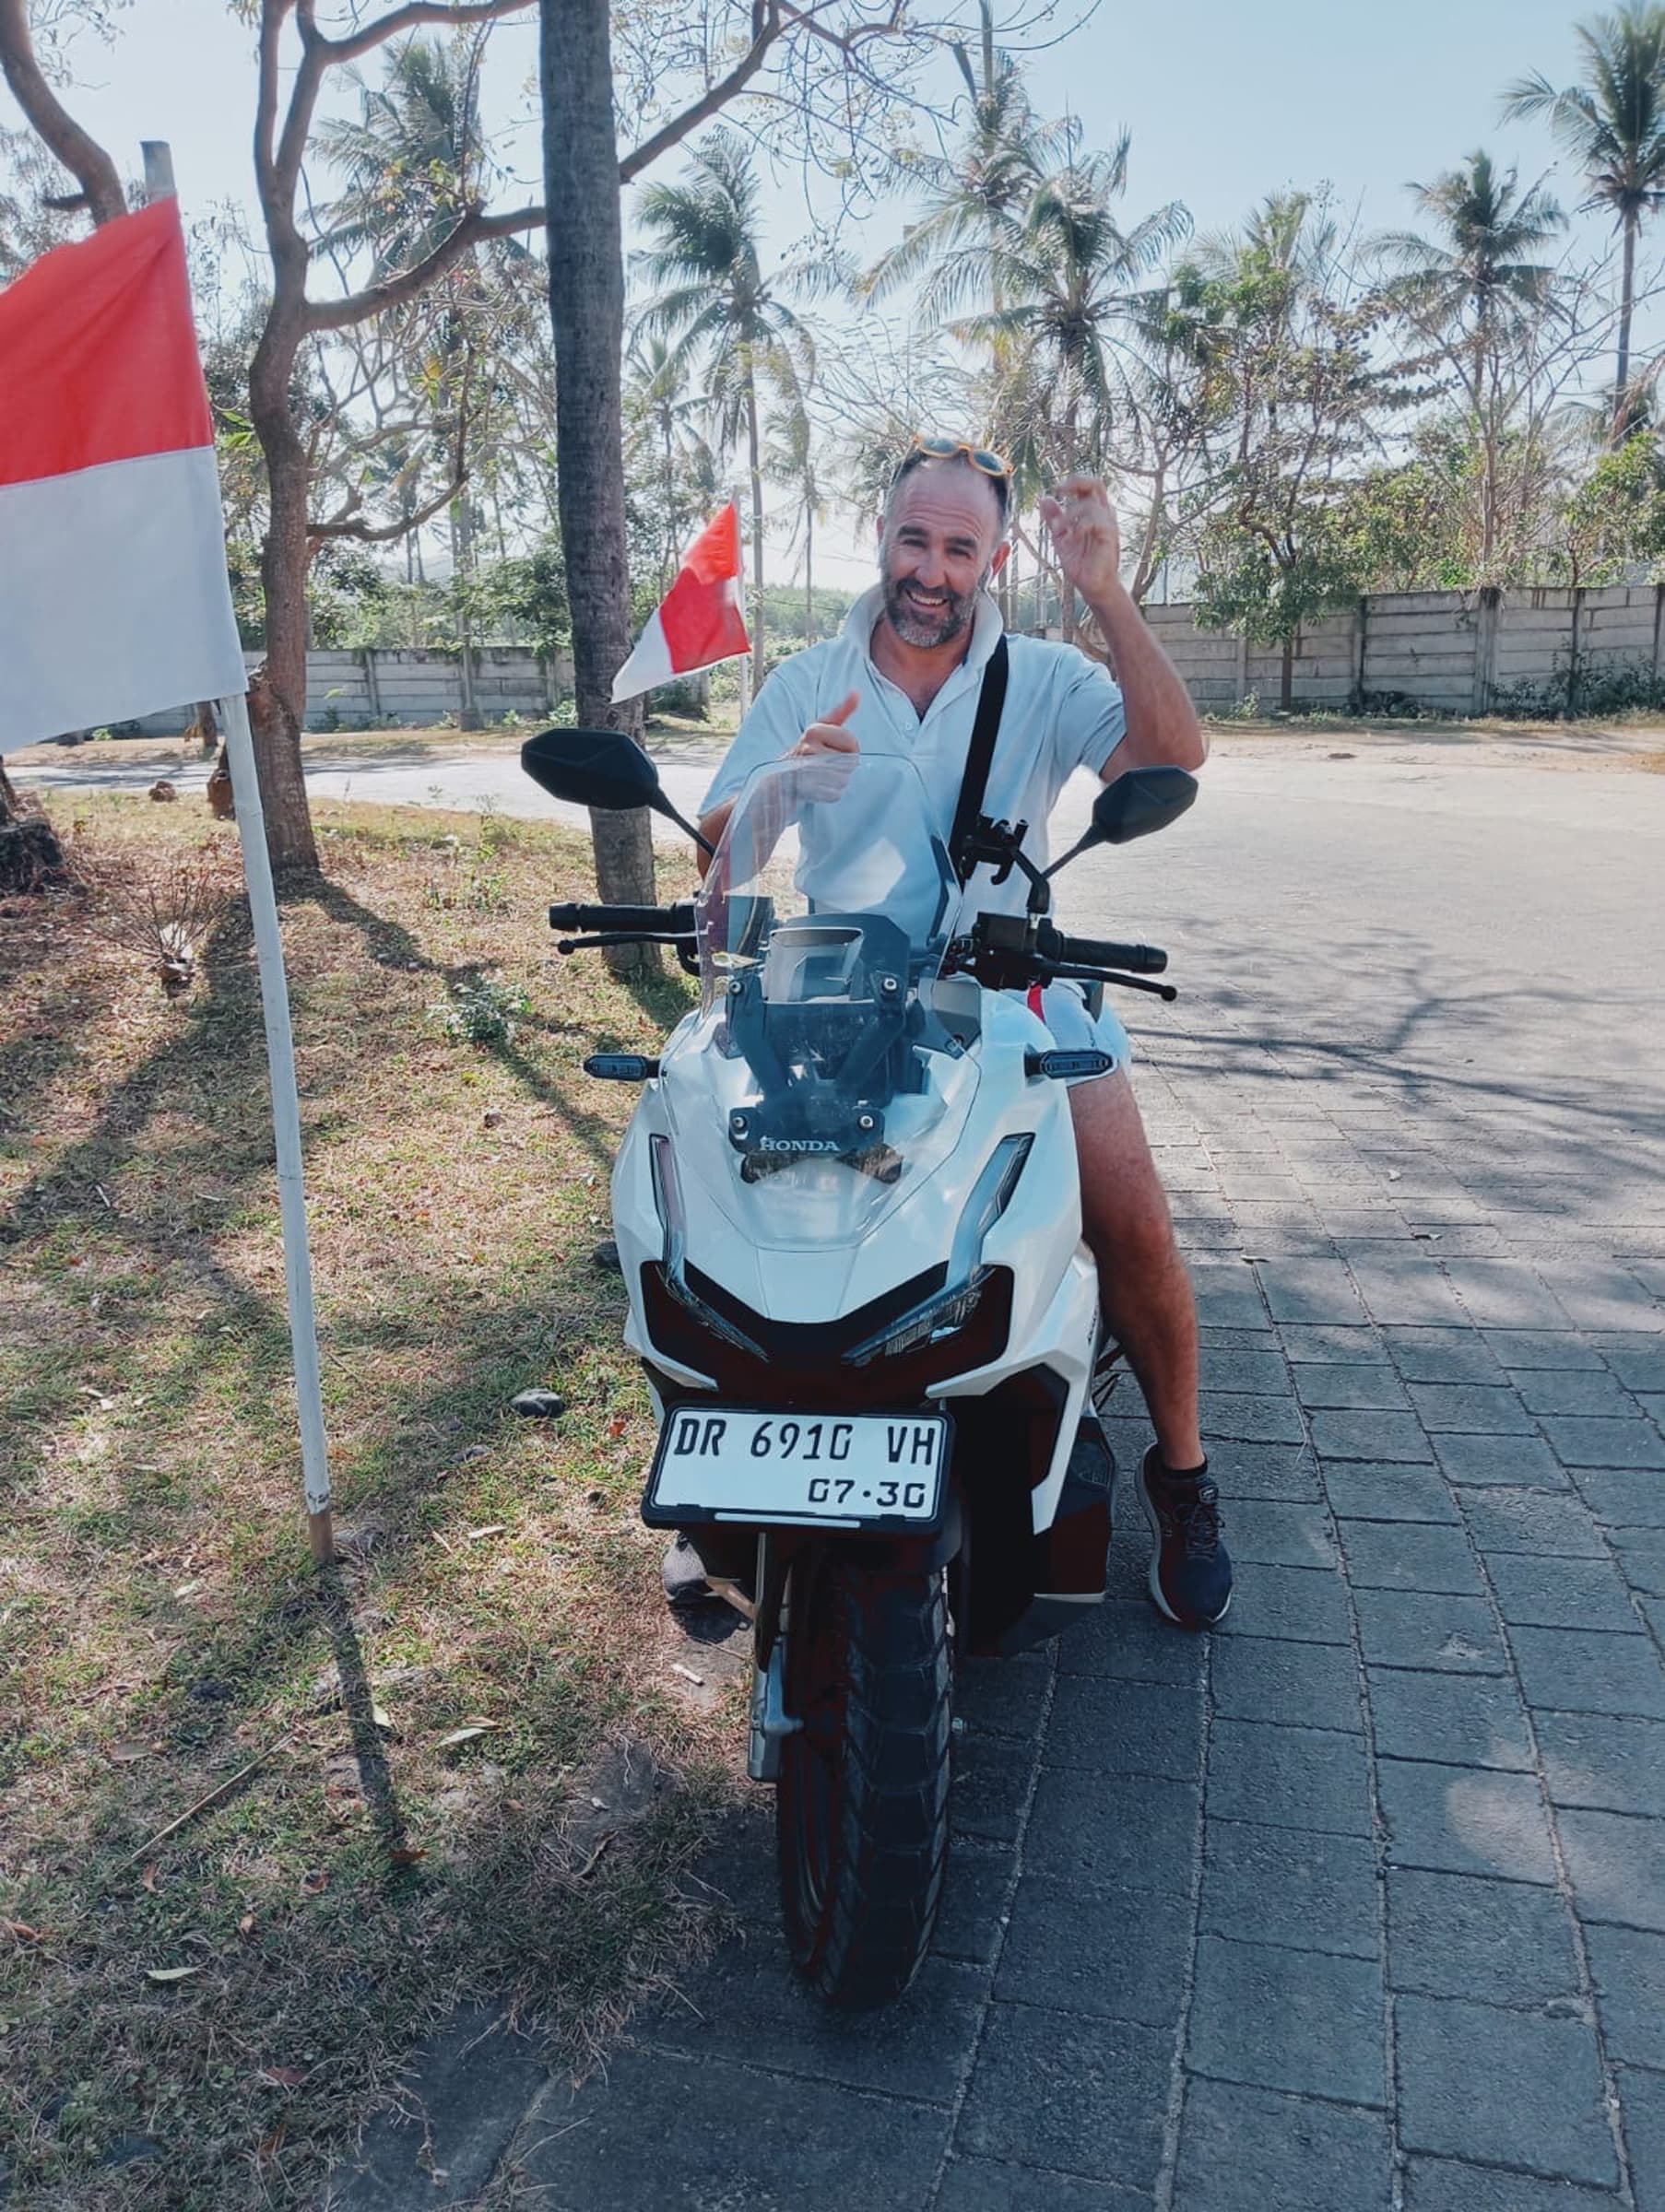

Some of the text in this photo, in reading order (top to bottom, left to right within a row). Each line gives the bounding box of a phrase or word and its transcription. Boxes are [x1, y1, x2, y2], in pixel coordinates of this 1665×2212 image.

[760, 1136, 841, 1151] HONDA
[674, 1418, 935, 1465] DR 6910 VH
